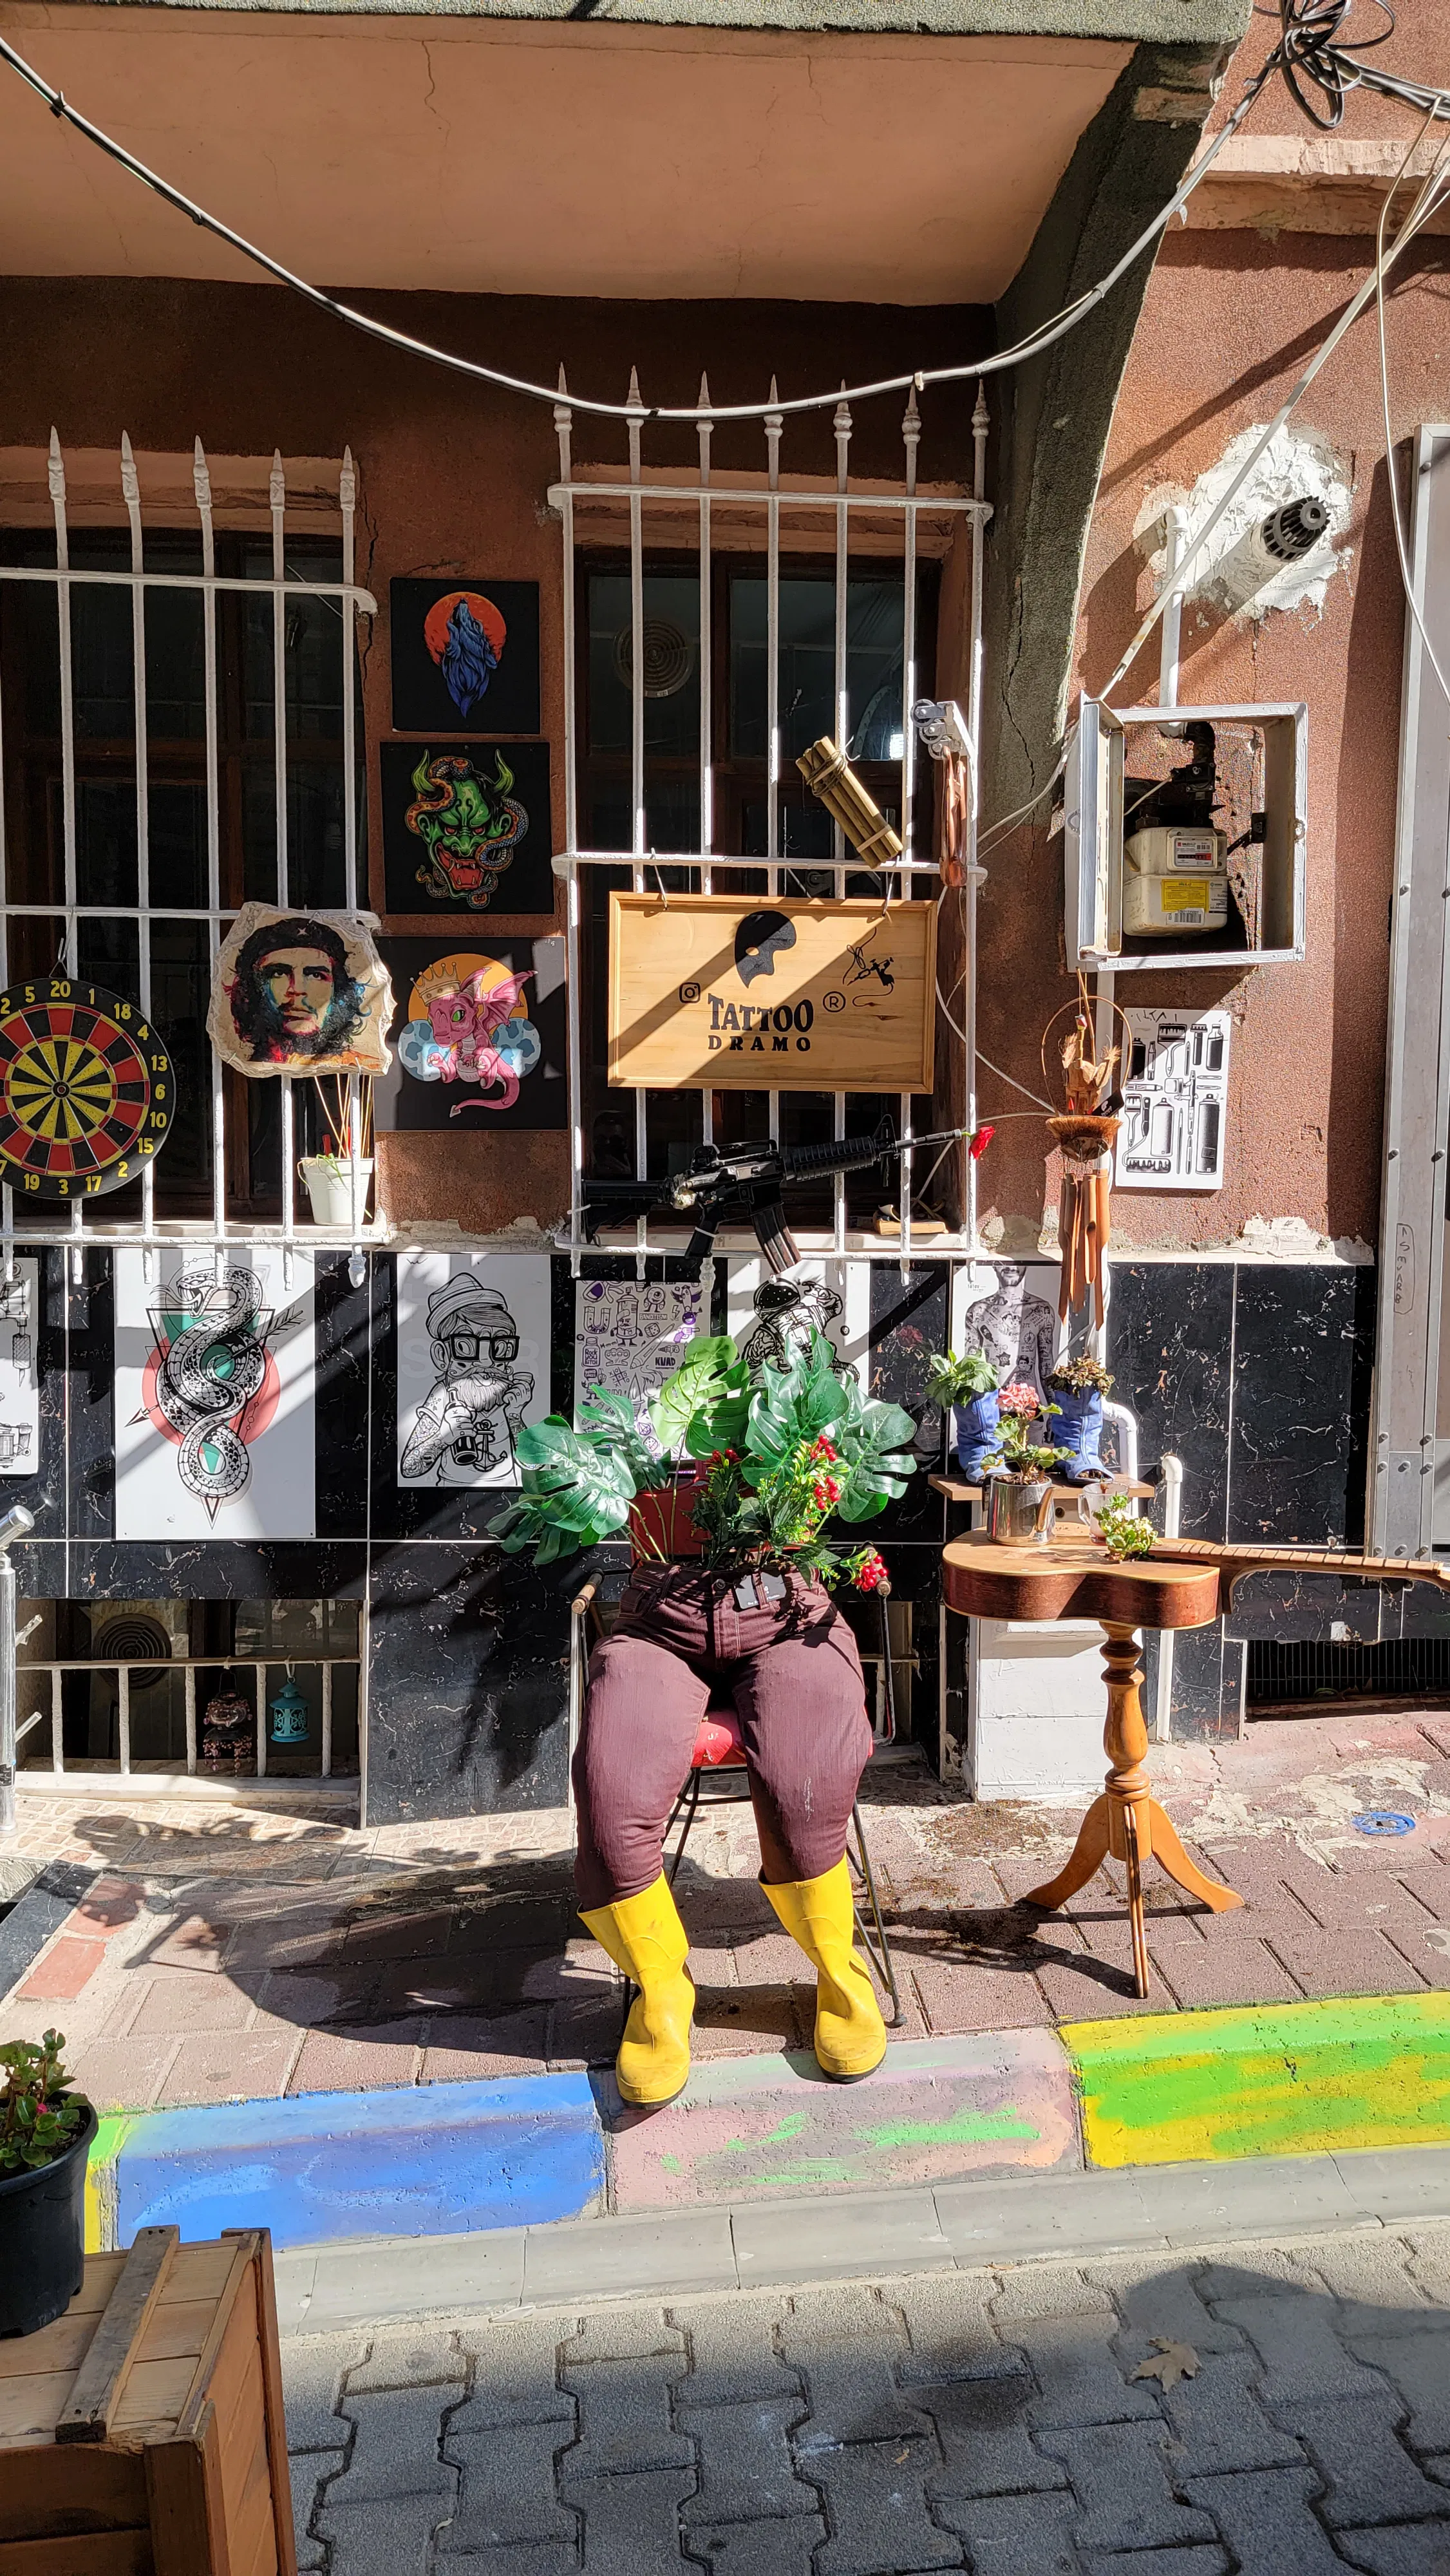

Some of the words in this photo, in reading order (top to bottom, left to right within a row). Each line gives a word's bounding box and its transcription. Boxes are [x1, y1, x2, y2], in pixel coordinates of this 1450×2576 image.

[25, 986, 35, 1003] 5
[50, 980, 71, 998] 20
[88, 989, 95, 1005] 1
[1, 998, 10, 1014] 2
[114, 1003, 131, 1019] 18
[708, 992, 814, 1032] TATTOO
[137, 1025, 149, 1040] 4
[708, 1035, 811, 1052] DRAMO
[151, 1055, 167, 1072] 13
[155, 1084, 165, 1100] 6
[151, 1112, 167, 1128] 10
[137, 1138, 154, 1154] 15
[118, 1162, 129, 1178] 2
[24, 1174, 40, 1191] 19
[59, 1179, 68, 1195] 3
[86, 1176, 102, 1192] 17
[655, 1357, 675, 1366] KVAD
